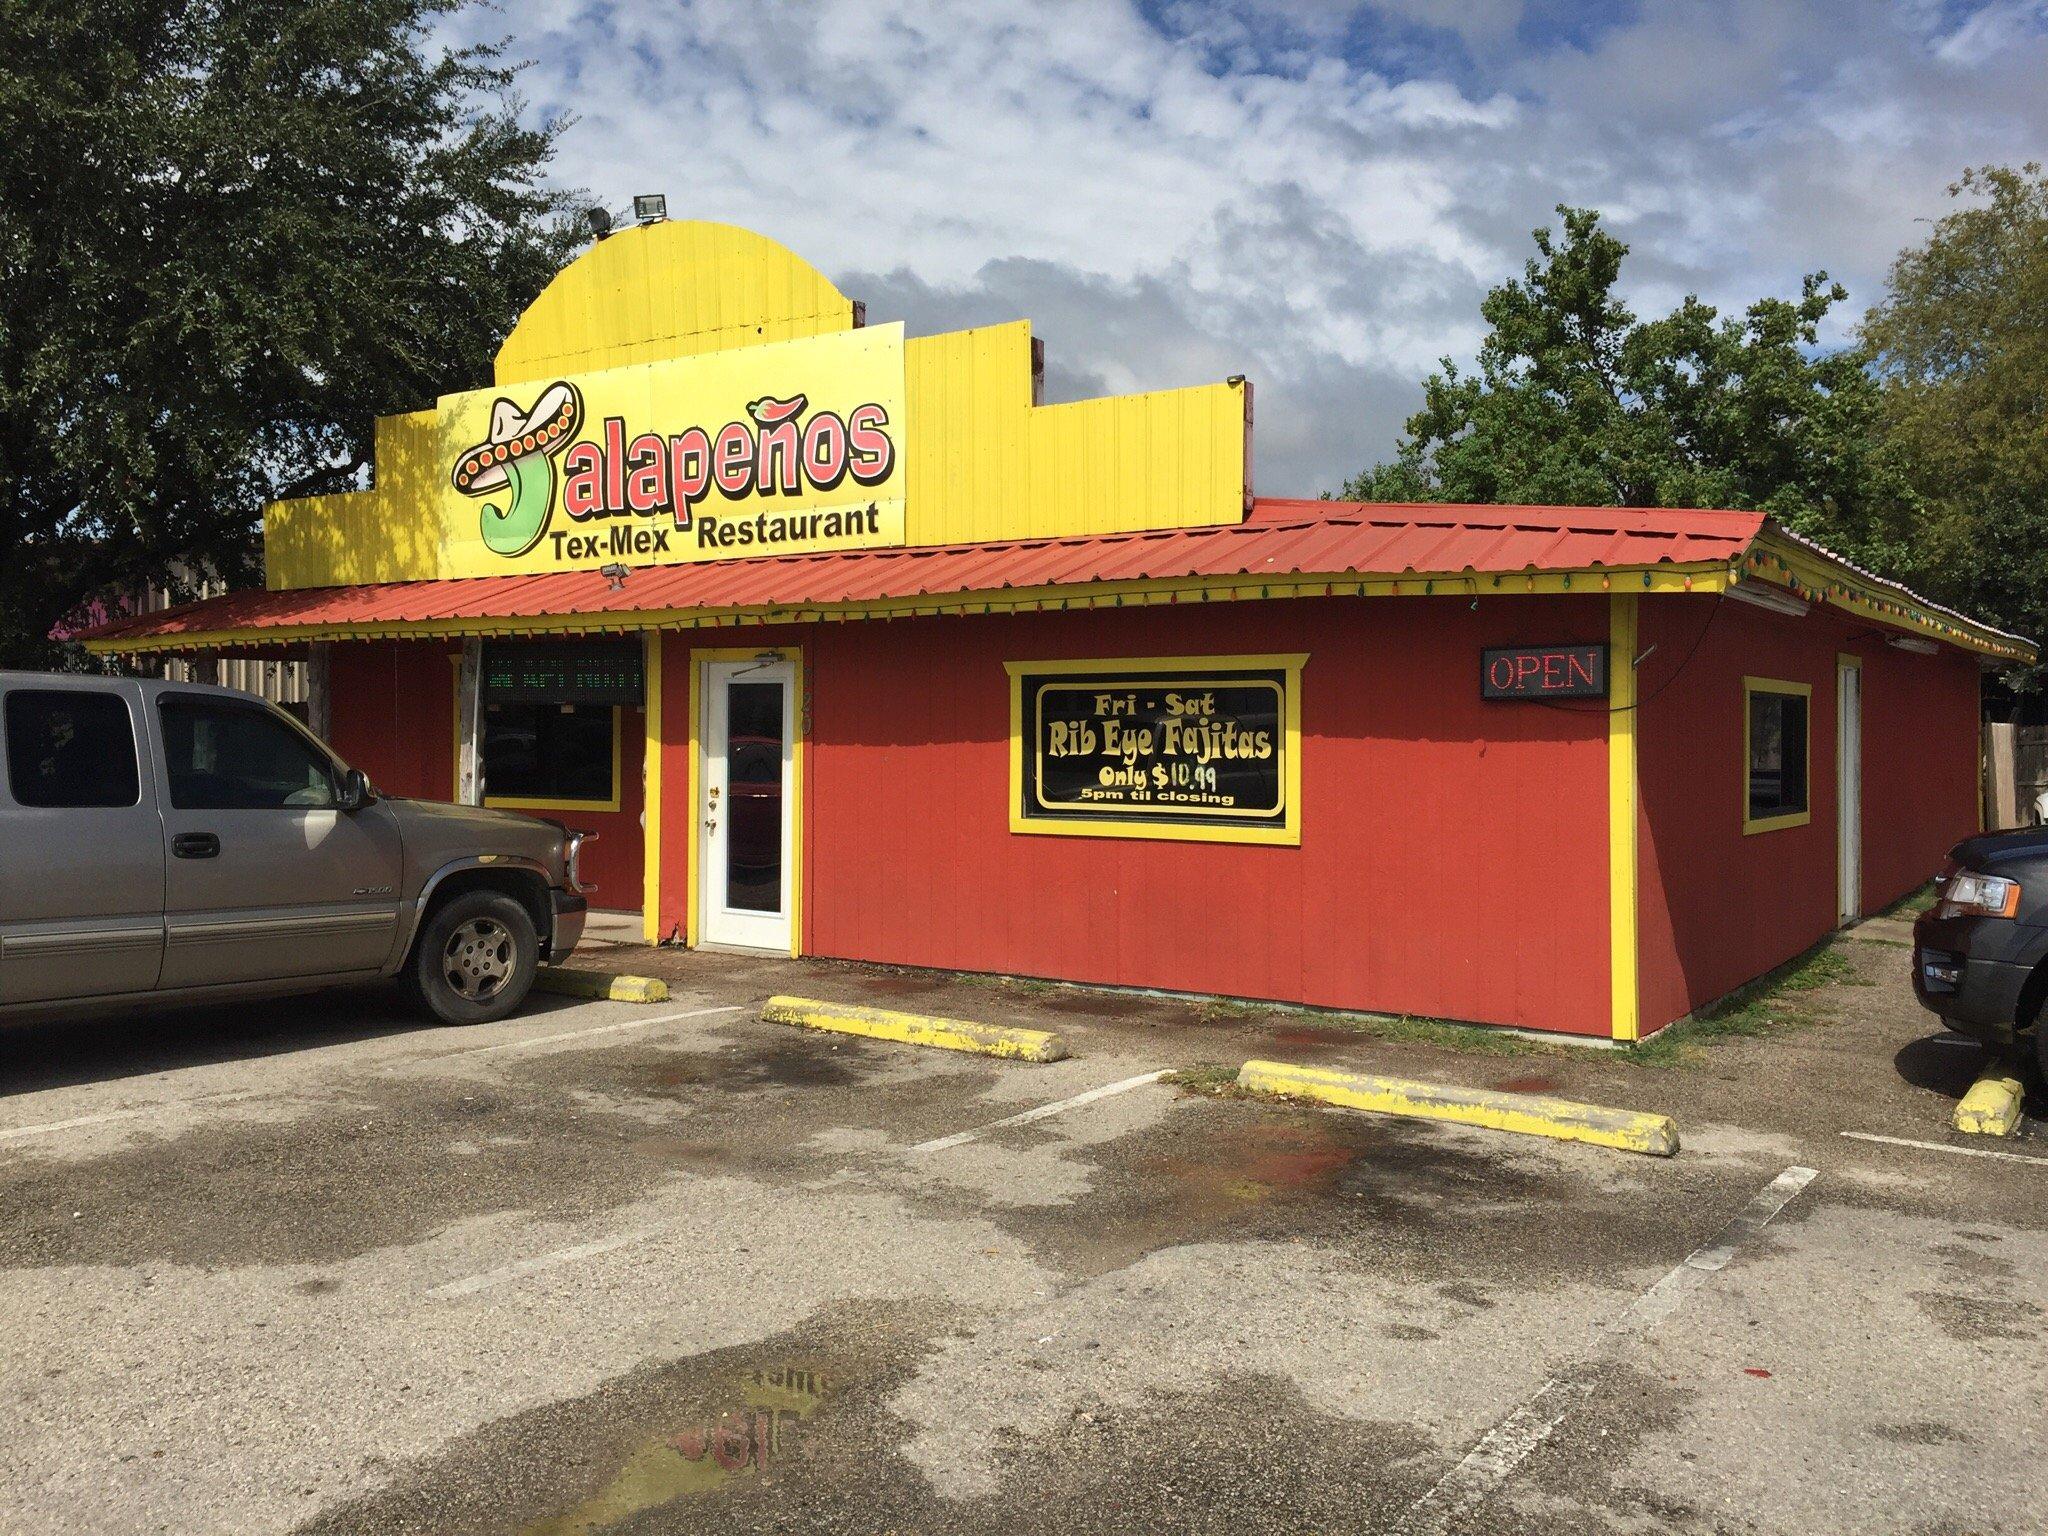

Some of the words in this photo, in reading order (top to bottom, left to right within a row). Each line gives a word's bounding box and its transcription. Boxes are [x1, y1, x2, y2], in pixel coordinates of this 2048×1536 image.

[452, 381, 896, 557] Jalapeños
[549, 524, 670, 560] Tex-Mex
[698, 503, 879, 548] Restaurant
[1490, 649, 1597, 690] OPEN
[1094, 694, 1137, 716] Fri
[1165, 693, 1215, 716] Sat
[1048, 720, 1096, 757] Rib
[1101, 719, 1153, 765] Eye
[1162, 717, 1272, 764] Fajitas
[1081, 788, 1124, 801] 5pm
[1130, 790, 1151, 801] til
[1156, 792, 1235, 806] closing
[1099, 765, 1147, 791] Only
